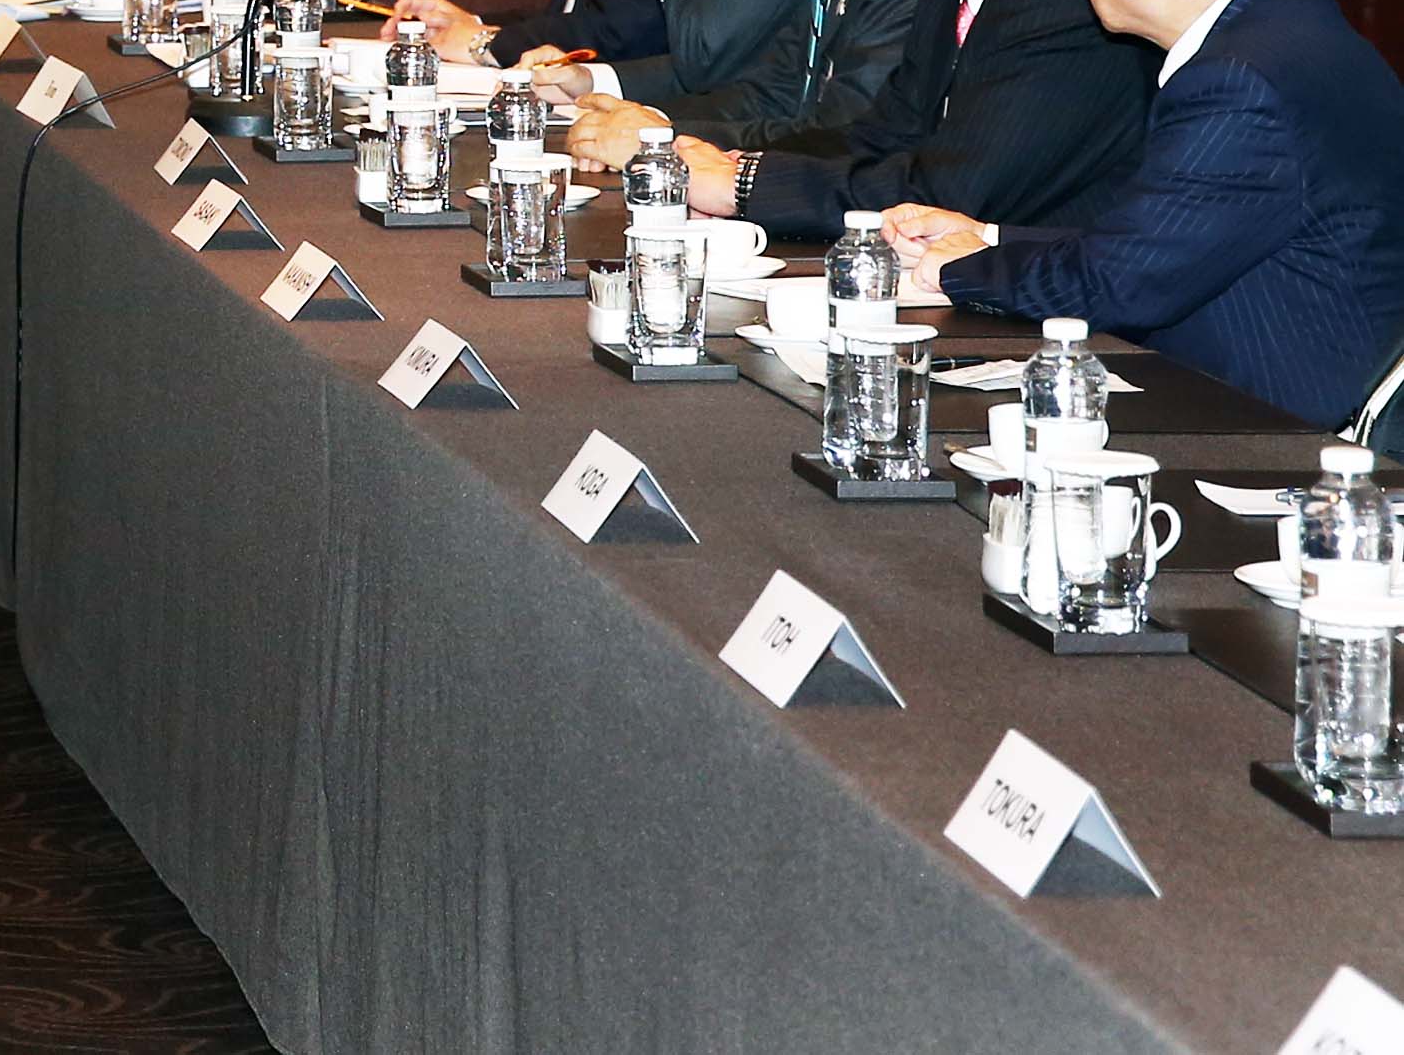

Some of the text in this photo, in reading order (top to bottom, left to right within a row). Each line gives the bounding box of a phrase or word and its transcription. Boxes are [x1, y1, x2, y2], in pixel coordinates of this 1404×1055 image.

[575, 464, 609, 502] KOGA
[760, 615, 802, 656] ITOH
[981, 778, 1046, 844] TOKURA
